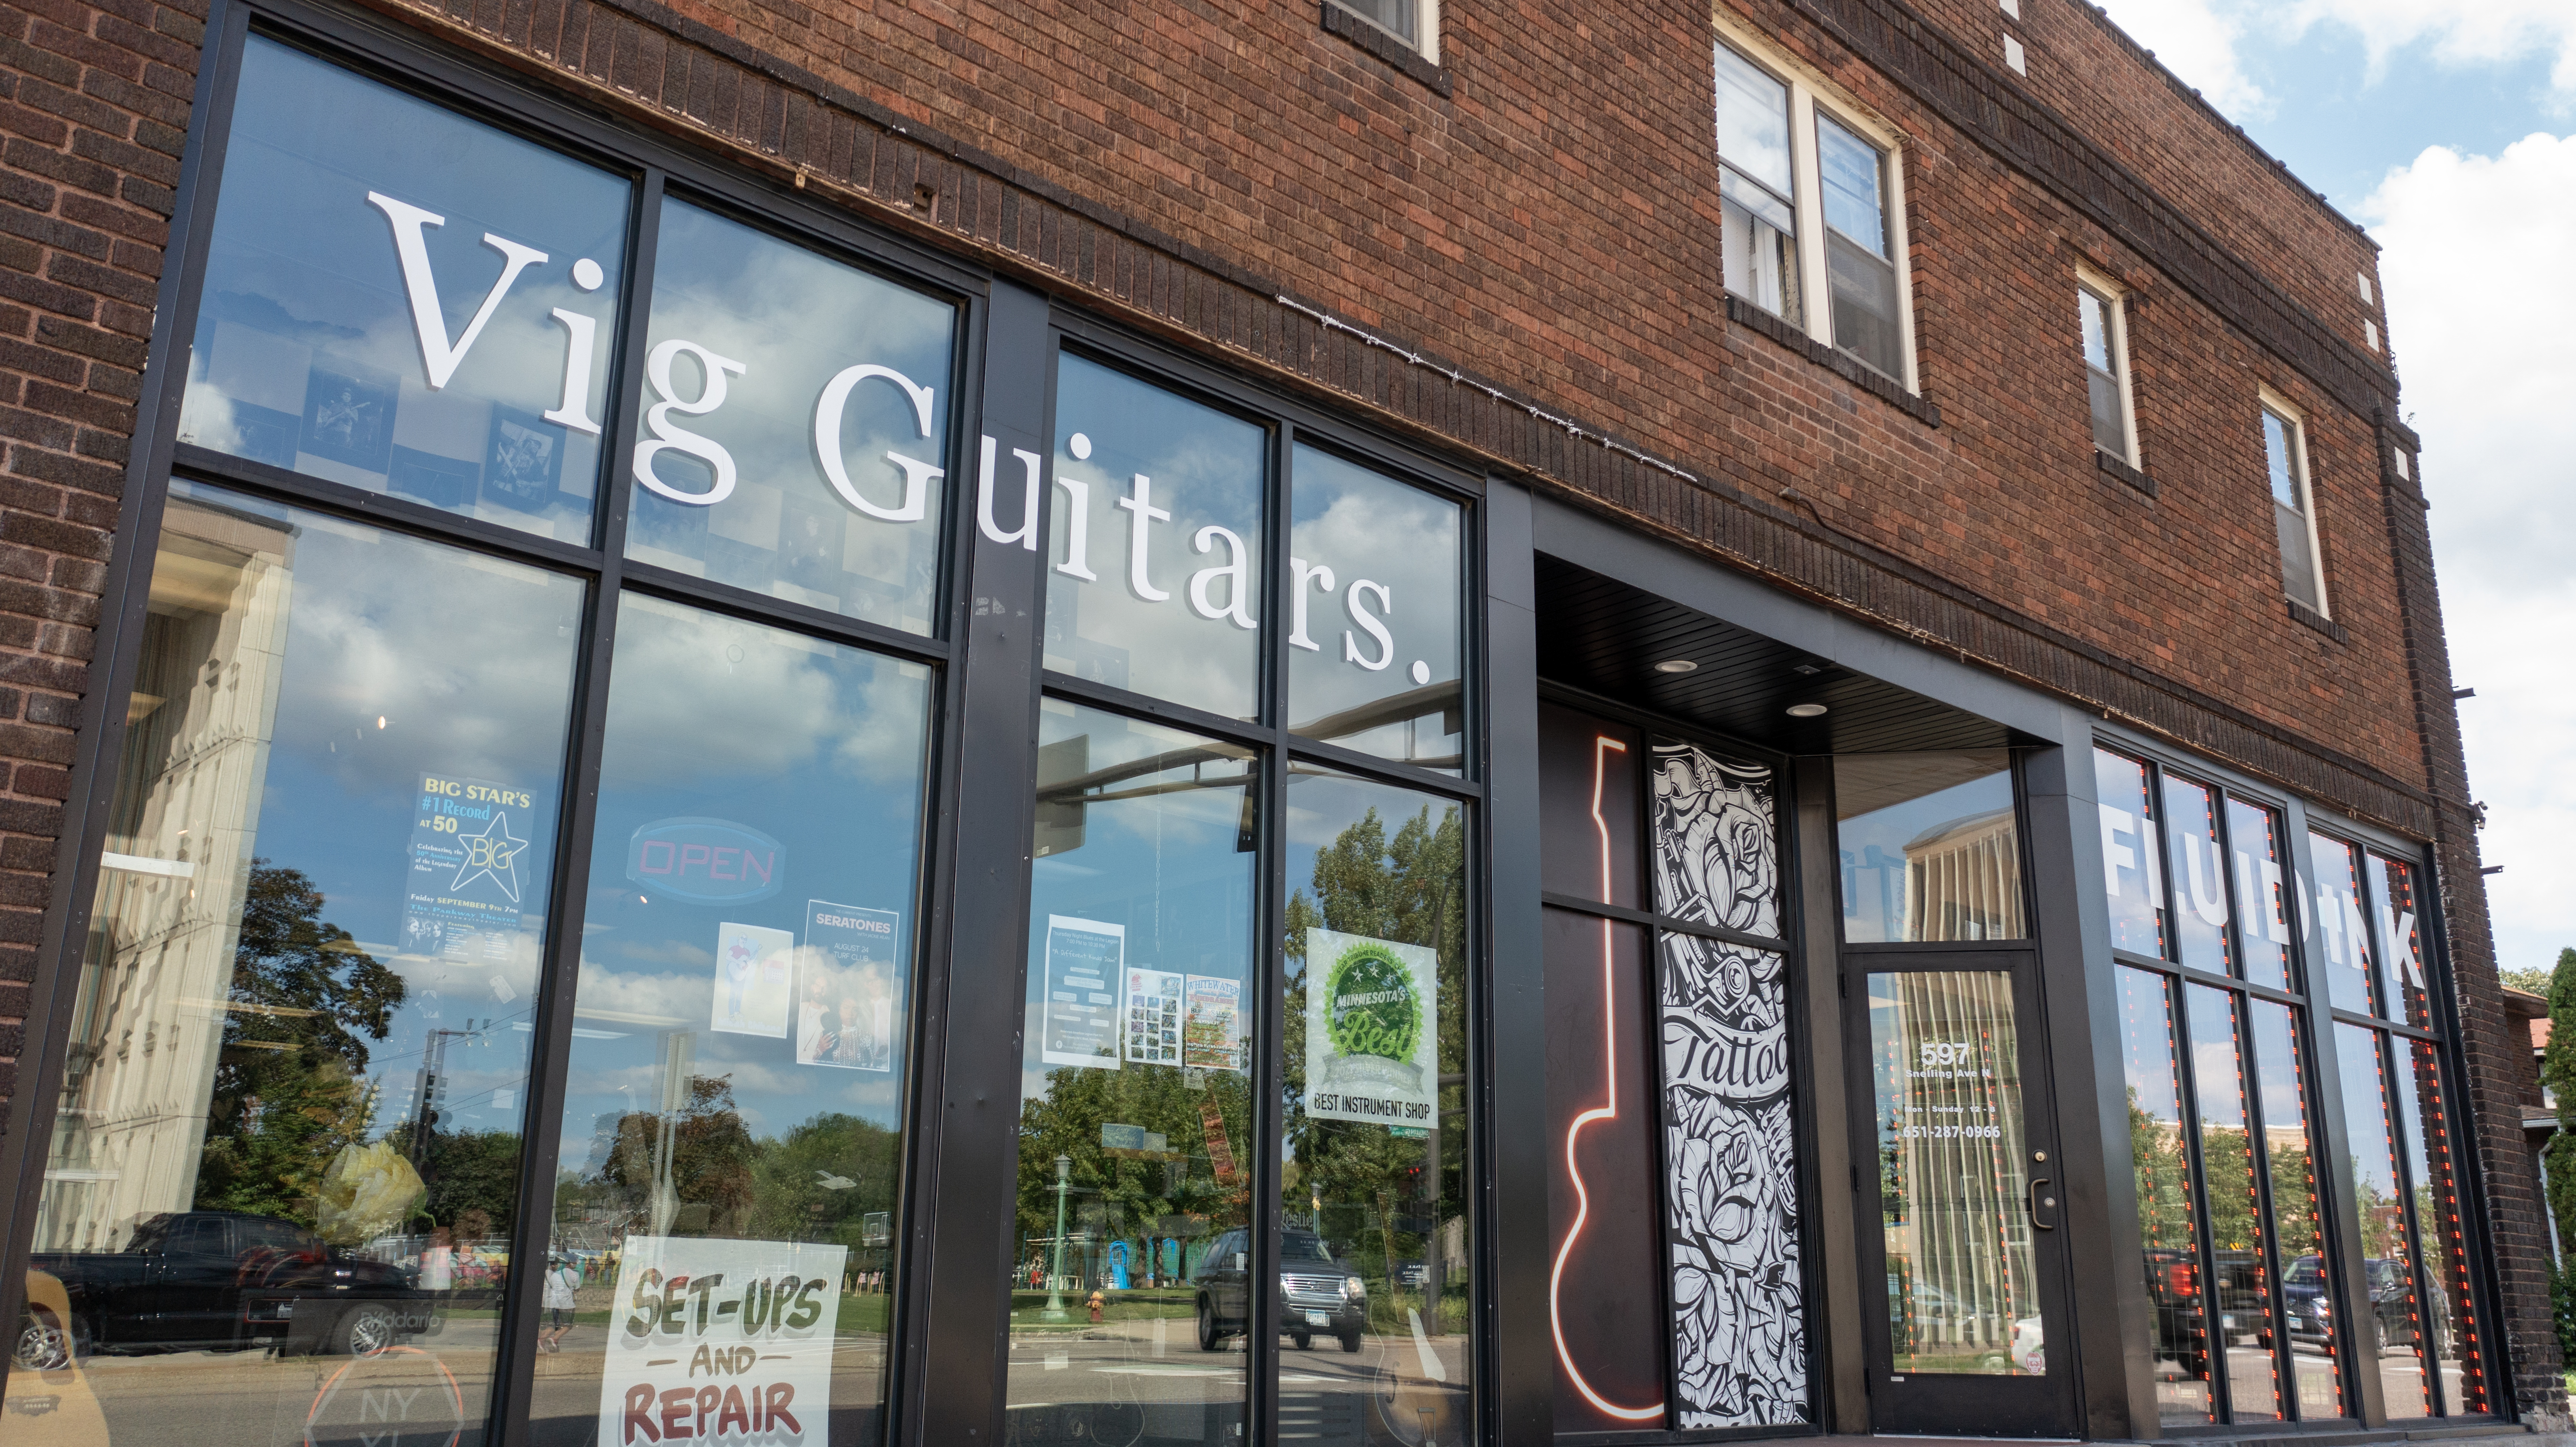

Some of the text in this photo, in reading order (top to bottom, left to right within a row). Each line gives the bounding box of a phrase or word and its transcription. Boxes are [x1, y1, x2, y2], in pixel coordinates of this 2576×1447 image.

[368, 191, 1433, 685] Vig Guitars.
[425, 778, 530, 808] BIG STAR'S
[422, 795, 491, 821] #1 Record
[420, 815, 458, 833] AT 50
[417, 843, 452, 855] Celebrating
[430, 852, 461, 863] Anniversary
[472, 838, 512, 869] BIG
[432, 859, 457, 869] Legendary
[639, 839, 776, 883] OPEN
[411, 893, 435, 904] Friday
[437, 897, 487, 909] SEPTEMBER
[504, 906, 518, 914] 7PM
[2098, 803, 2426, 990] FLUID INK
[432, 906, 476, 918] Parkway
[479, 913, 517, 923] Theater
[816, 913, 891, 933] SERATONES
[834, 943, 860, 952] AUGUST
[834, 951, 868, 962] TURF CLUB
[1061, 949, 1087, 959] Different
[1089, 953, 1102, 961] Kinda
[1337, 960, 1348, 975] STAR
[1347, 950, 1369, 962] TRIBUNE
[1394, 963, 1410, 985] CHOICE
[1187, 980, 1239, 996] WHITEWATER
[1336, 989, 1405, 1007] MINNESOTA'S
[1338, 1011, 1411, 1057] Best
[1664, 1015, 1787, 1087] Tattoo
[1921, 1043, 1969, 1065] 597
[1906, 1069, 1952, 1078] Snelling
[1982, 1069, 1989, 1077] N
[1314, 1093, 1430, 1119] BEST INSTRUMENT SHOP
[1903, 1126, 2000, 1138] 651-287-0966
[625, 1267, 828, 1343] SET-UPS
[361, 1310, 441, 1329] D'Addario
[689, 1342, 756, 1379] AND
[359, 1389, 422, 1422] NY
[621, 1382, 804, 1447] REPAIR
